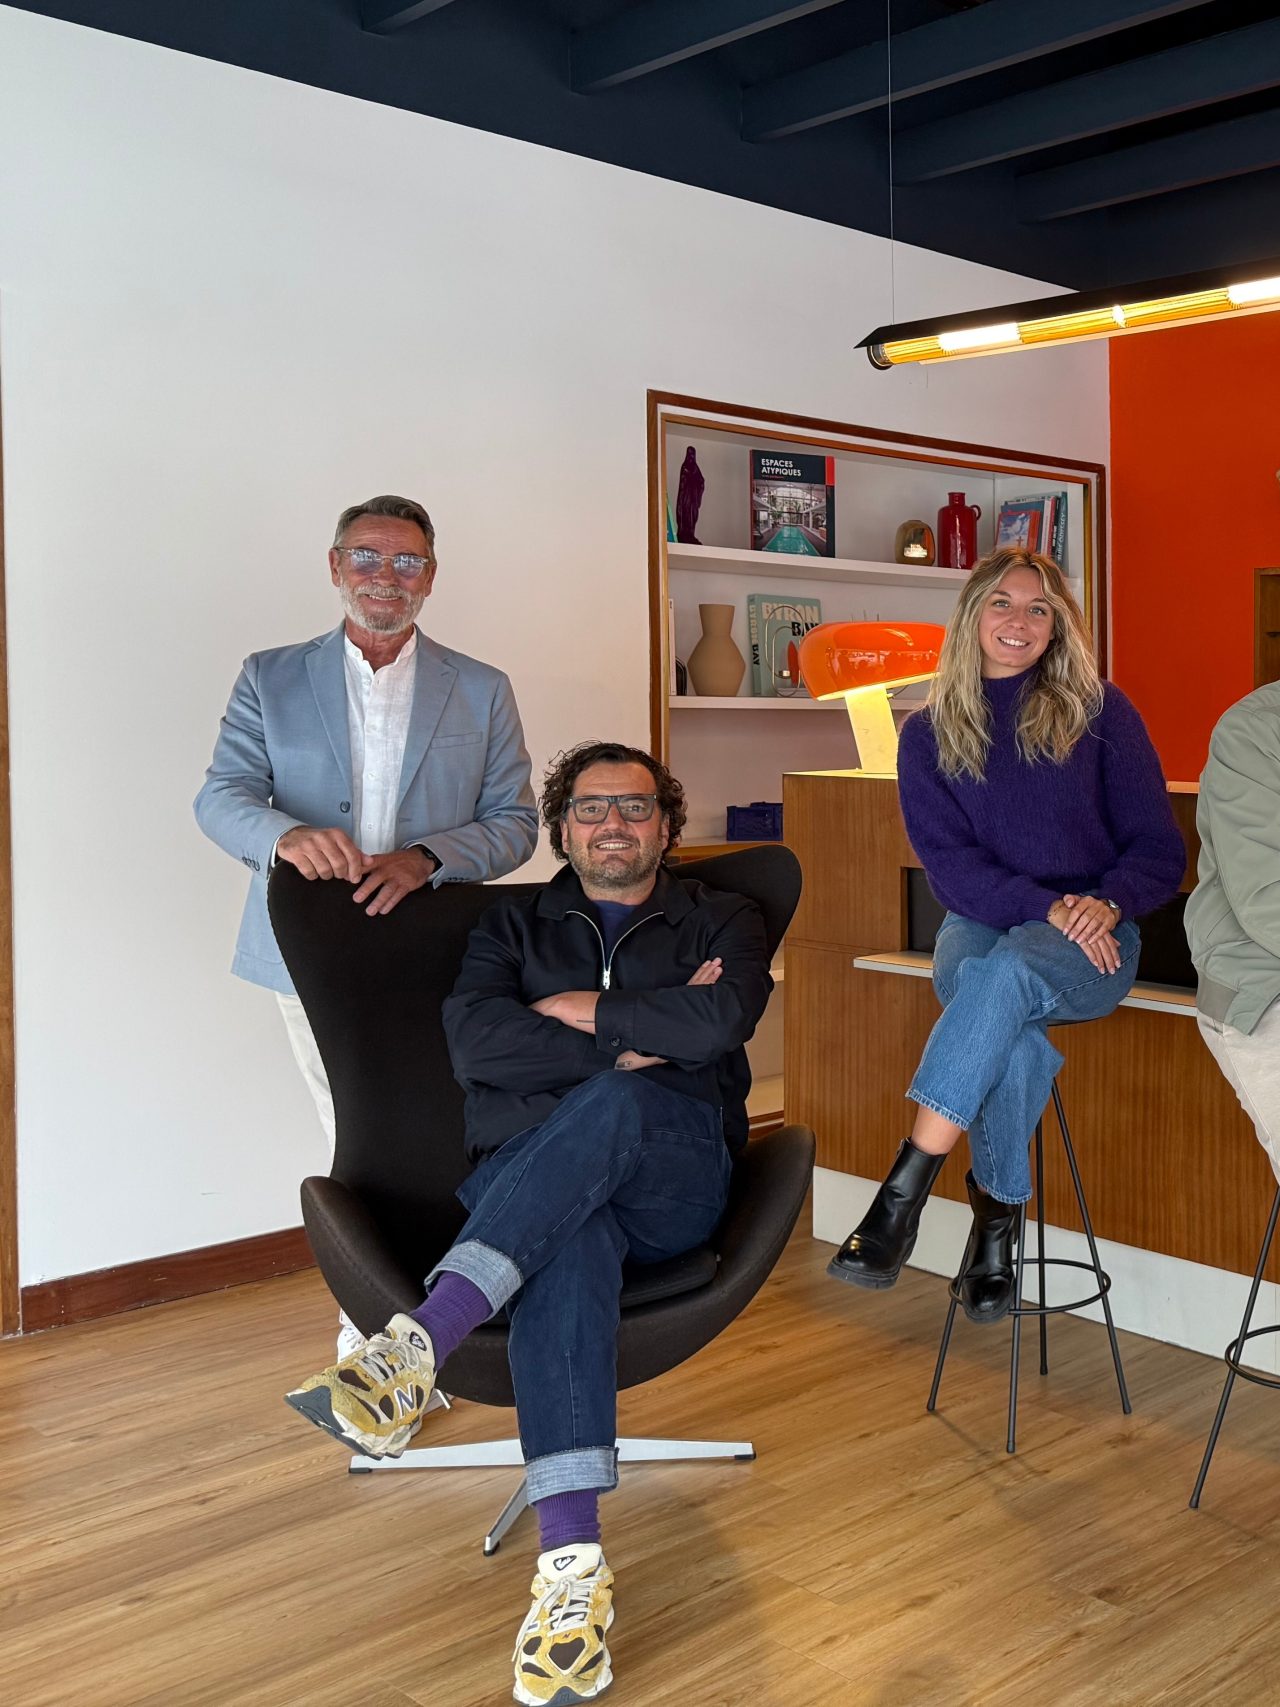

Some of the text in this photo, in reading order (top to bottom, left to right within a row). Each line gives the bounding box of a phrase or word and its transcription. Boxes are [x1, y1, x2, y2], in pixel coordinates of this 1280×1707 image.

[761, 459, 794, 468] ESPACES
[761, 467, 802, 477] ATYPIQUES
[762, 602, 820, 621] BYRON
[752, 643, 760, 666] BAY
[394, 1381, 416, 1420] N
